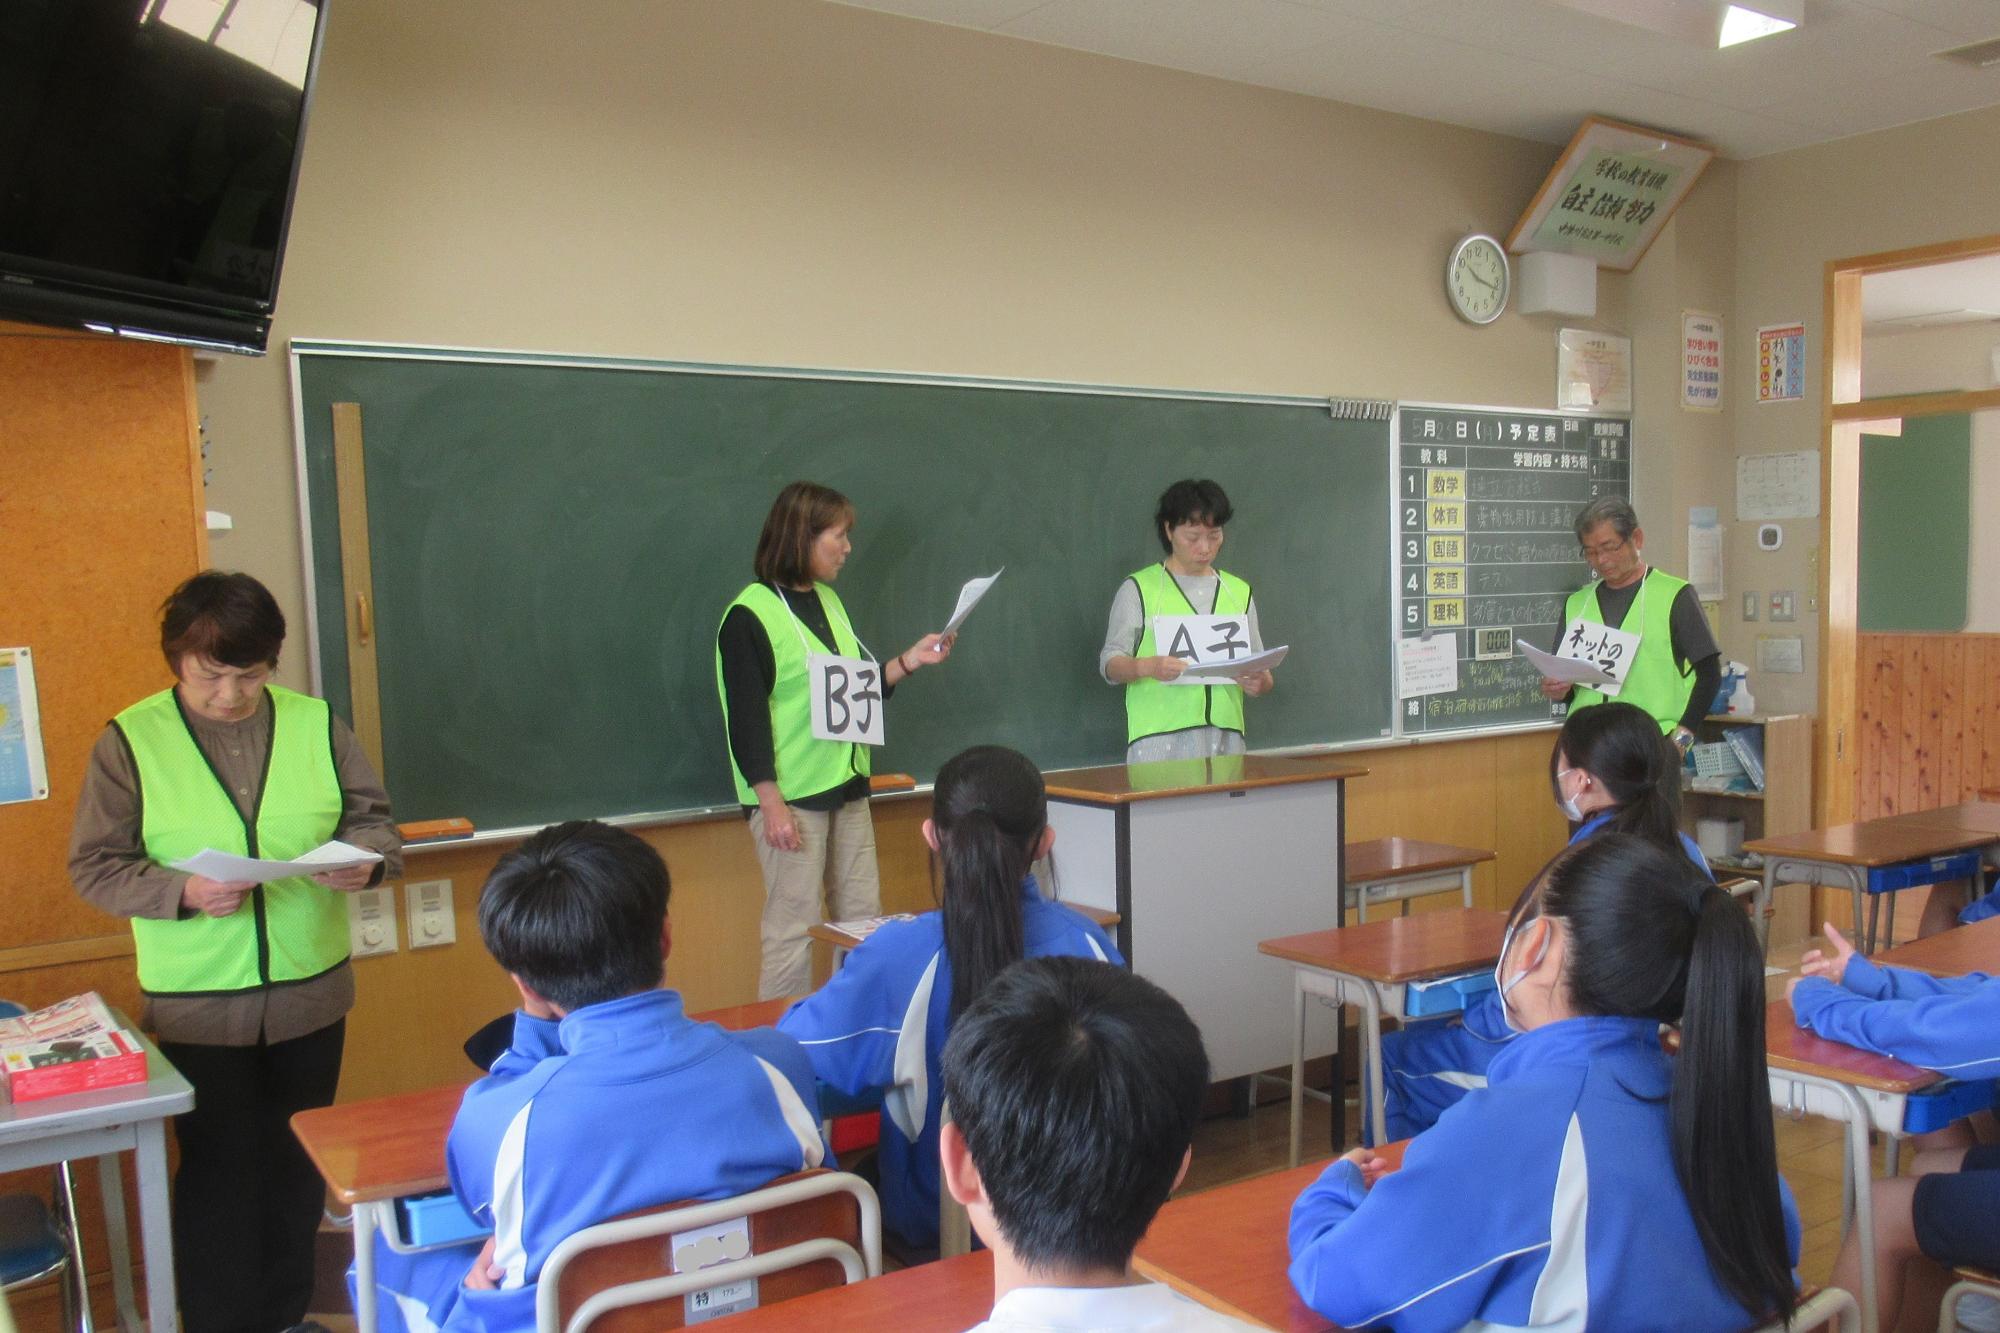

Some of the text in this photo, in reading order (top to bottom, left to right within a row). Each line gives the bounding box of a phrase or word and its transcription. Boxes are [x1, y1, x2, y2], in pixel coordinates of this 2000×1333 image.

[1424, 420, 1436, 437] 月
[1456, 421, 1467, 438] 日
[1510, 424, 1556, 442] 予定表
[1421, 449, 1447, 464] 教科
[1514, 452, 1588, 468] 学習内容・持ち物
[1408, 475, 1415, 493] 1
[1433, 476, 1458, 493] 数学
[1591, 485, 1598, 495] 2
[1406, 508, 1417, 525] 2
[1433, 507, 1458, 524] 体育
[1407, 541, 1418, 558] 3
[1433, 541, 1458, 557] 国語
[1407, 573, 1418, 591] 4
[1433, 572, 1458, 590] 英語
[1407, 606, 1418, 623] 5
[1433, 604, 1458, 621] 理科
[1569, 624, 1623, 660] ネットの
[824, 664, 881, 734] B子
[695, 1291, 709, 1307] 特
